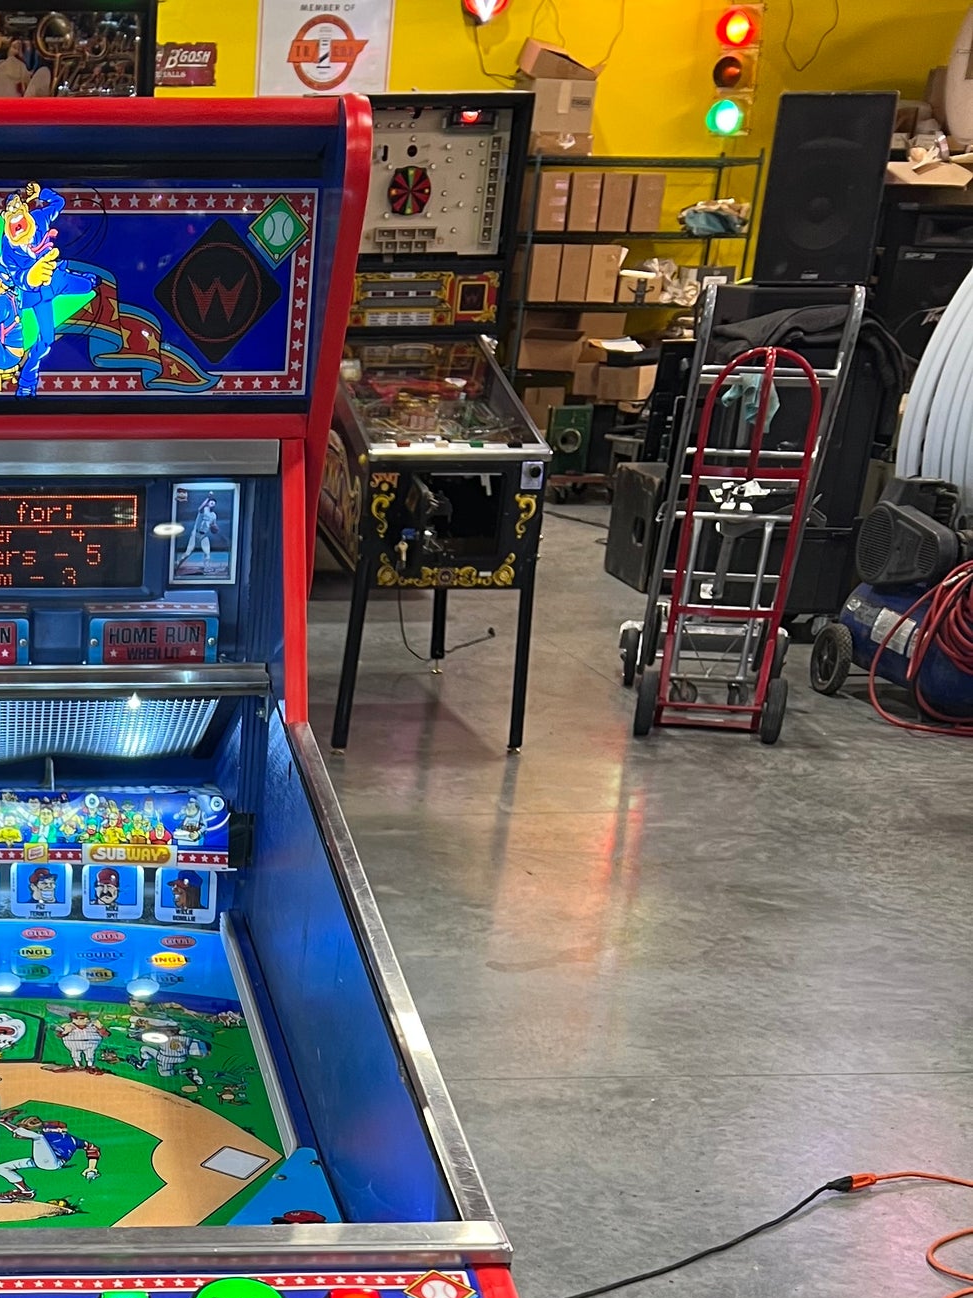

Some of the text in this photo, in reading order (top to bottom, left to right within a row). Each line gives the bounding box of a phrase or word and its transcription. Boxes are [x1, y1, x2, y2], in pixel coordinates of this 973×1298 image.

[17, 501, 72, 523] for:
[86, 544, 101, 565] 5
[62, 568, 77, 586] 3
[109, 626, 201, 644] HOME RUN
[128, 647, 182, 660] WHEN LIT
[92, 846, 169, 862] SUBWAY
[26, 930, 53, 938] OUT
[95, 933, 121, 941] OUT
[164, 938, 192, 946] OUT
